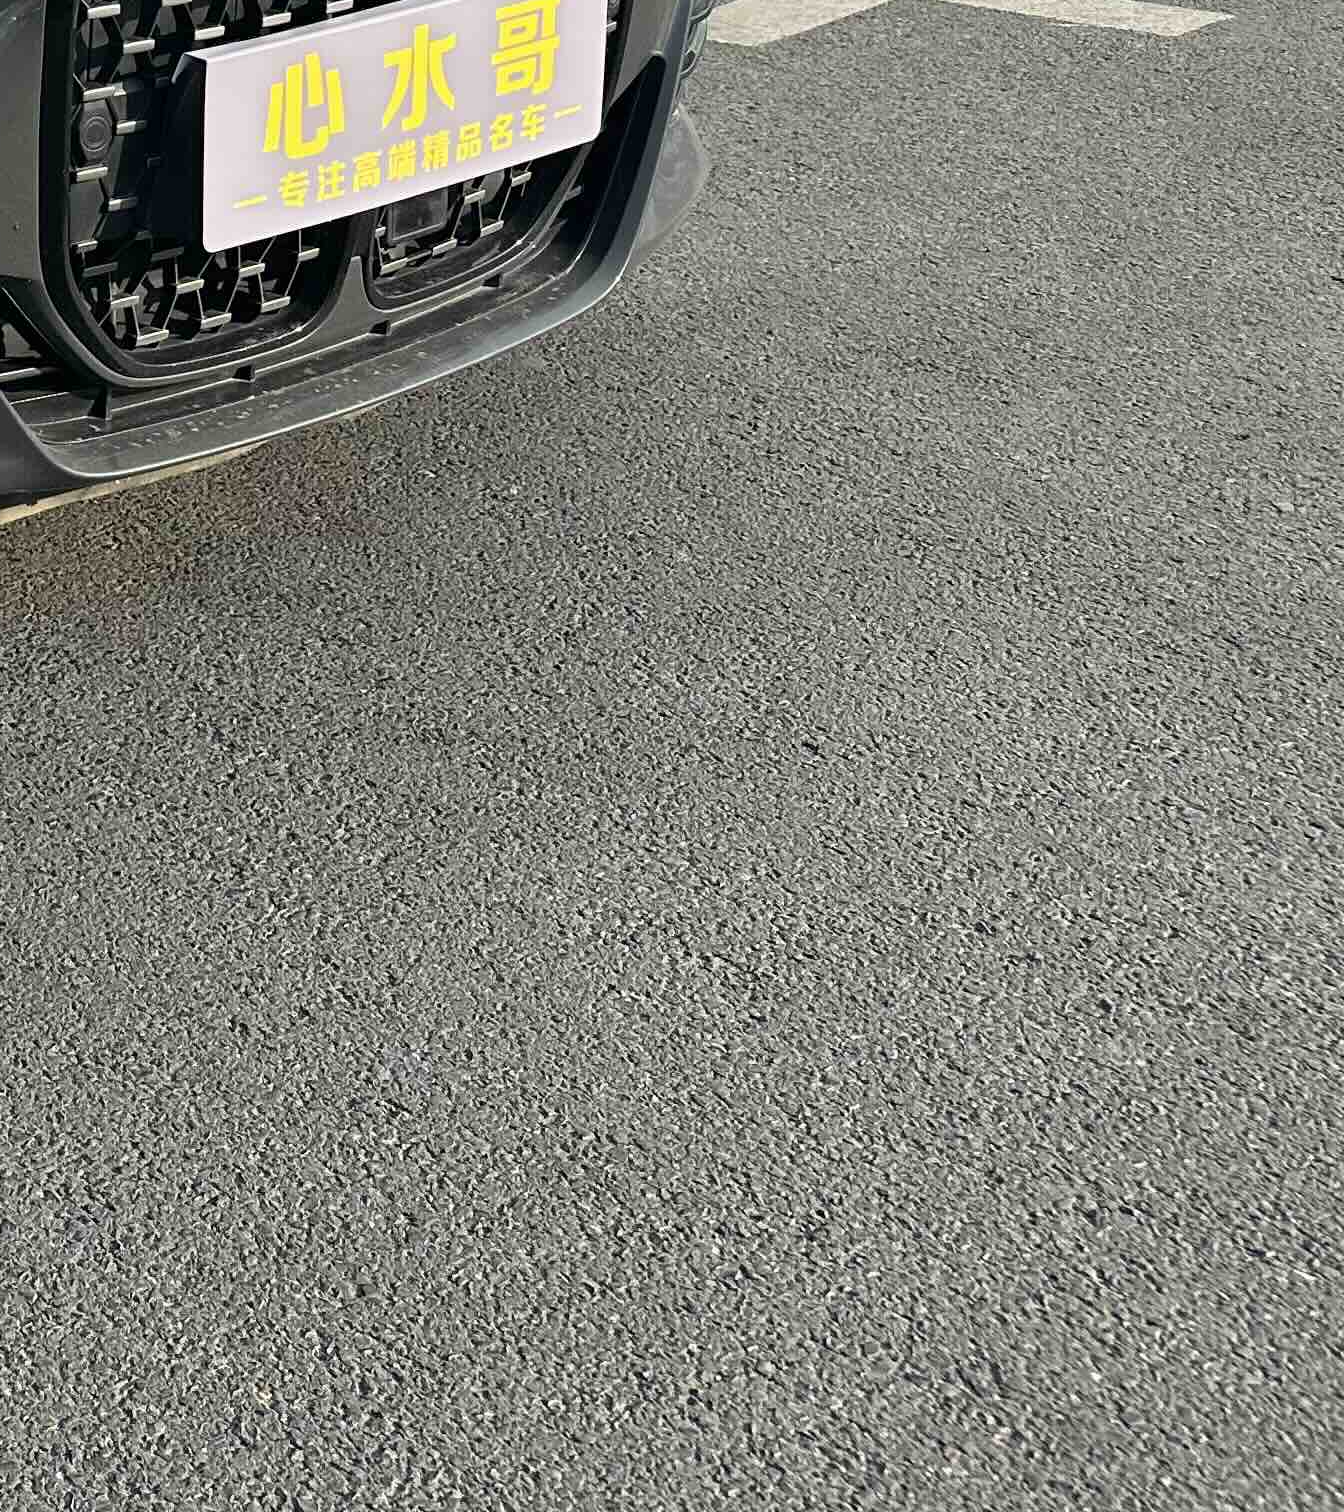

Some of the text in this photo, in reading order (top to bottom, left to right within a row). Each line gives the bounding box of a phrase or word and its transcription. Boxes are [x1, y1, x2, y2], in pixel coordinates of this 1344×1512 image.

[278, 103, 548, 208] 专注高端精品名车
